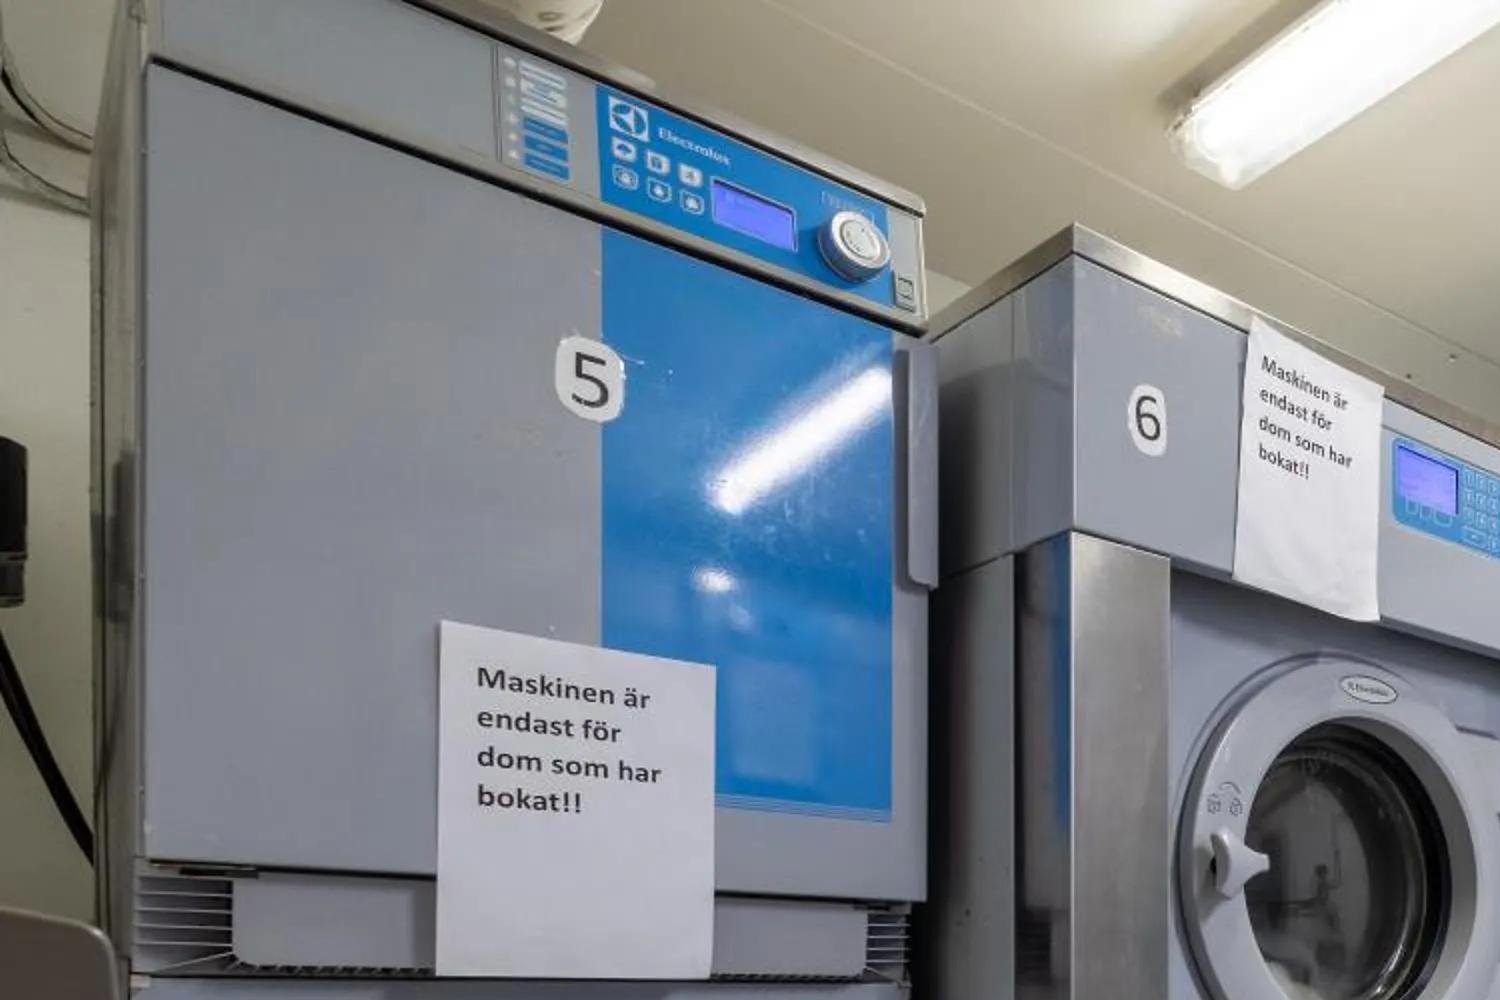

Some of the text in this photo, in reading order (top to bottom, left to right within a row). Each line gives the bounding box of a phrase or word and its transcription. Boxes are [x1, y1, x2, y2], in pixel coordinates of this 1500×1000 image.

[659, 127, 731, 166] Electrolux
[572, 351, 609, 408] 5
[1261, 355, 1348, 411] Maskinen är
[1135, 395, 1161, 441] 6
[1259, 386, 1332, 432] endast för
[1259, 415, 1353, 470] dom som har
[1259, 442, 1310, 480] bokat!!
[477, 667, 652, 710] Maskinen är
[477, 711, 622, 744] endast för
[477, 745, 662, 784] dom som har
[477, 783, 582, 814] bokat!!
